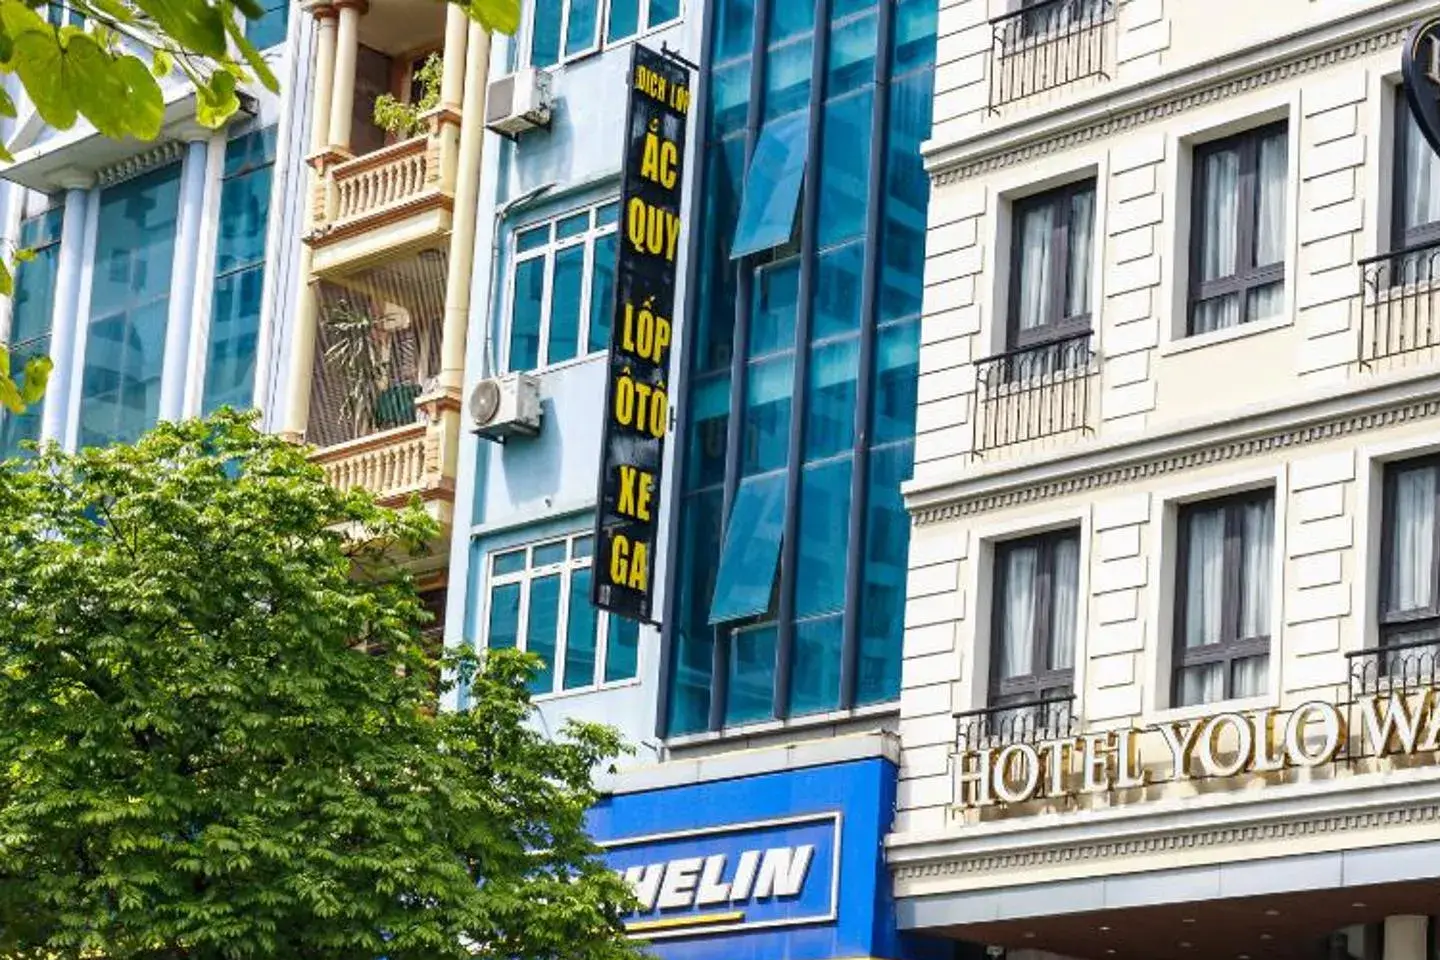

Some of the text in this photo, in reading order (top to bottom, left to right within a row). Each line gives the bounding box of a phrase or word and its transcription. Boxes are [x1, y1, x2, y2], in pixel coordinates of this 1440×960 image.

[627, 196, 680, 262] QUY
[622, 295, 670, 365] LỐP
[616, 365, 668, 440] ÔTÔ
[619, 465, 653, 522] XE
[611, 533, 648, 592] GA
[950, 728, 1145, 809] HOTEL
[1161, 701, 1347, 779] YOLO
[618, 843, 816, 916] HELIN
